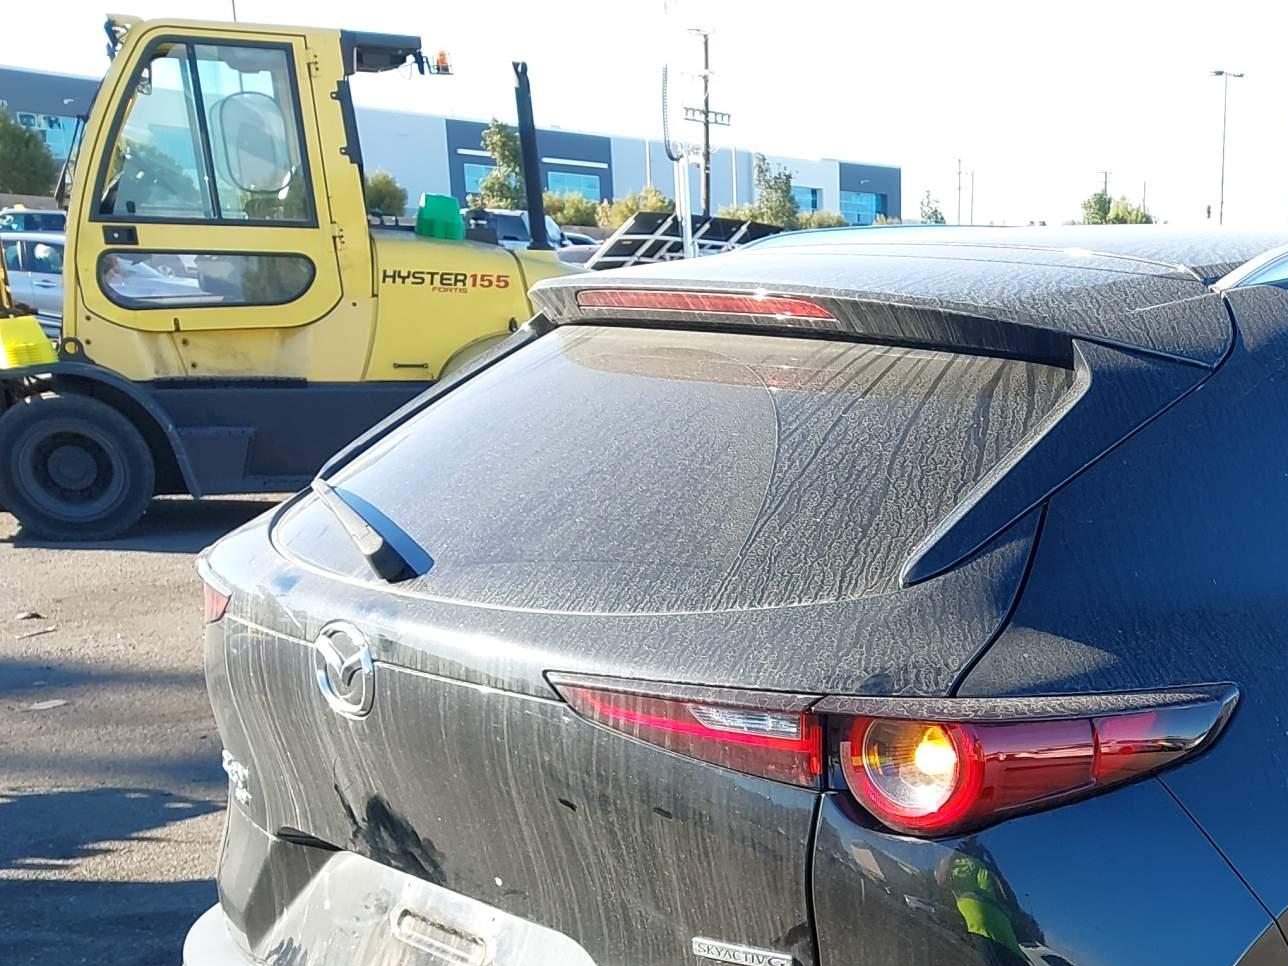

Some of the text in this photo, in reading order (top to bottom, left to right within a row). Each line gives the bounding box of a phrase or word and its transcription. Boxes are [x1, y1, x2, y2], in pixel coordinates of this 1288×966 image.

[382, 269, 510, 289] HYSTER 155
[432, 286, 468, 294] FORTIS
